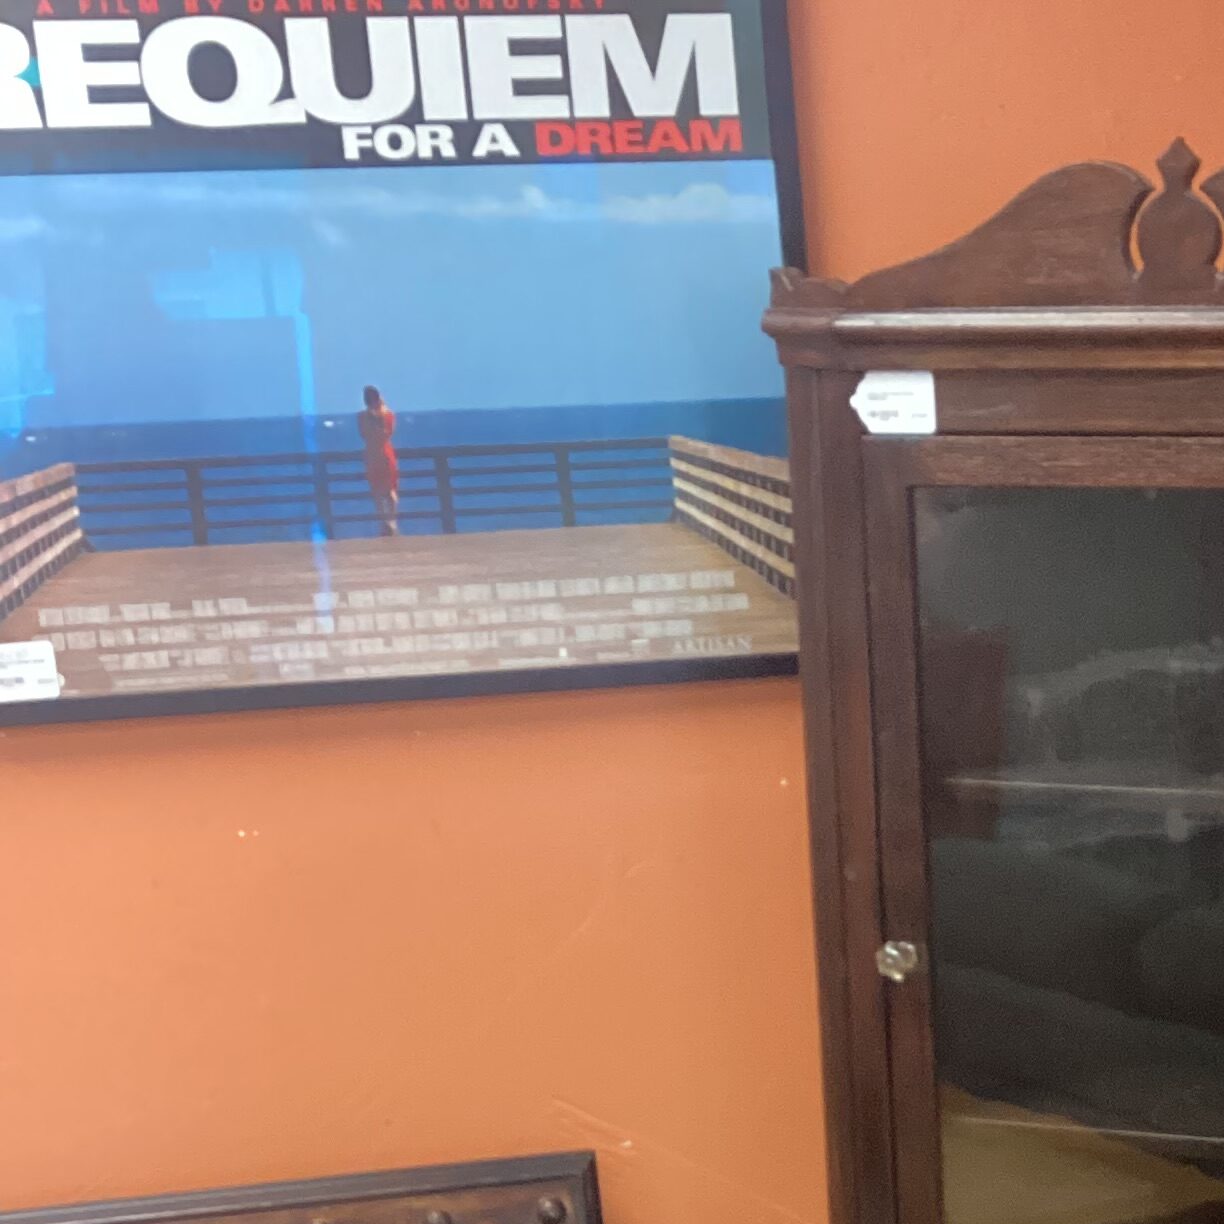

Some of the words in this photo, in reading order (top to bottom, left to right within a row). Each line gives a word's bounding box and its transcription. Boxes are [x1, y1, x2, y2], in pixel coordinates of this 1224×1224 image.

[341, 123, 456, 160] FOR
[472, 123, 521, 158] A
[535, 119, 743, 156] DREAM
